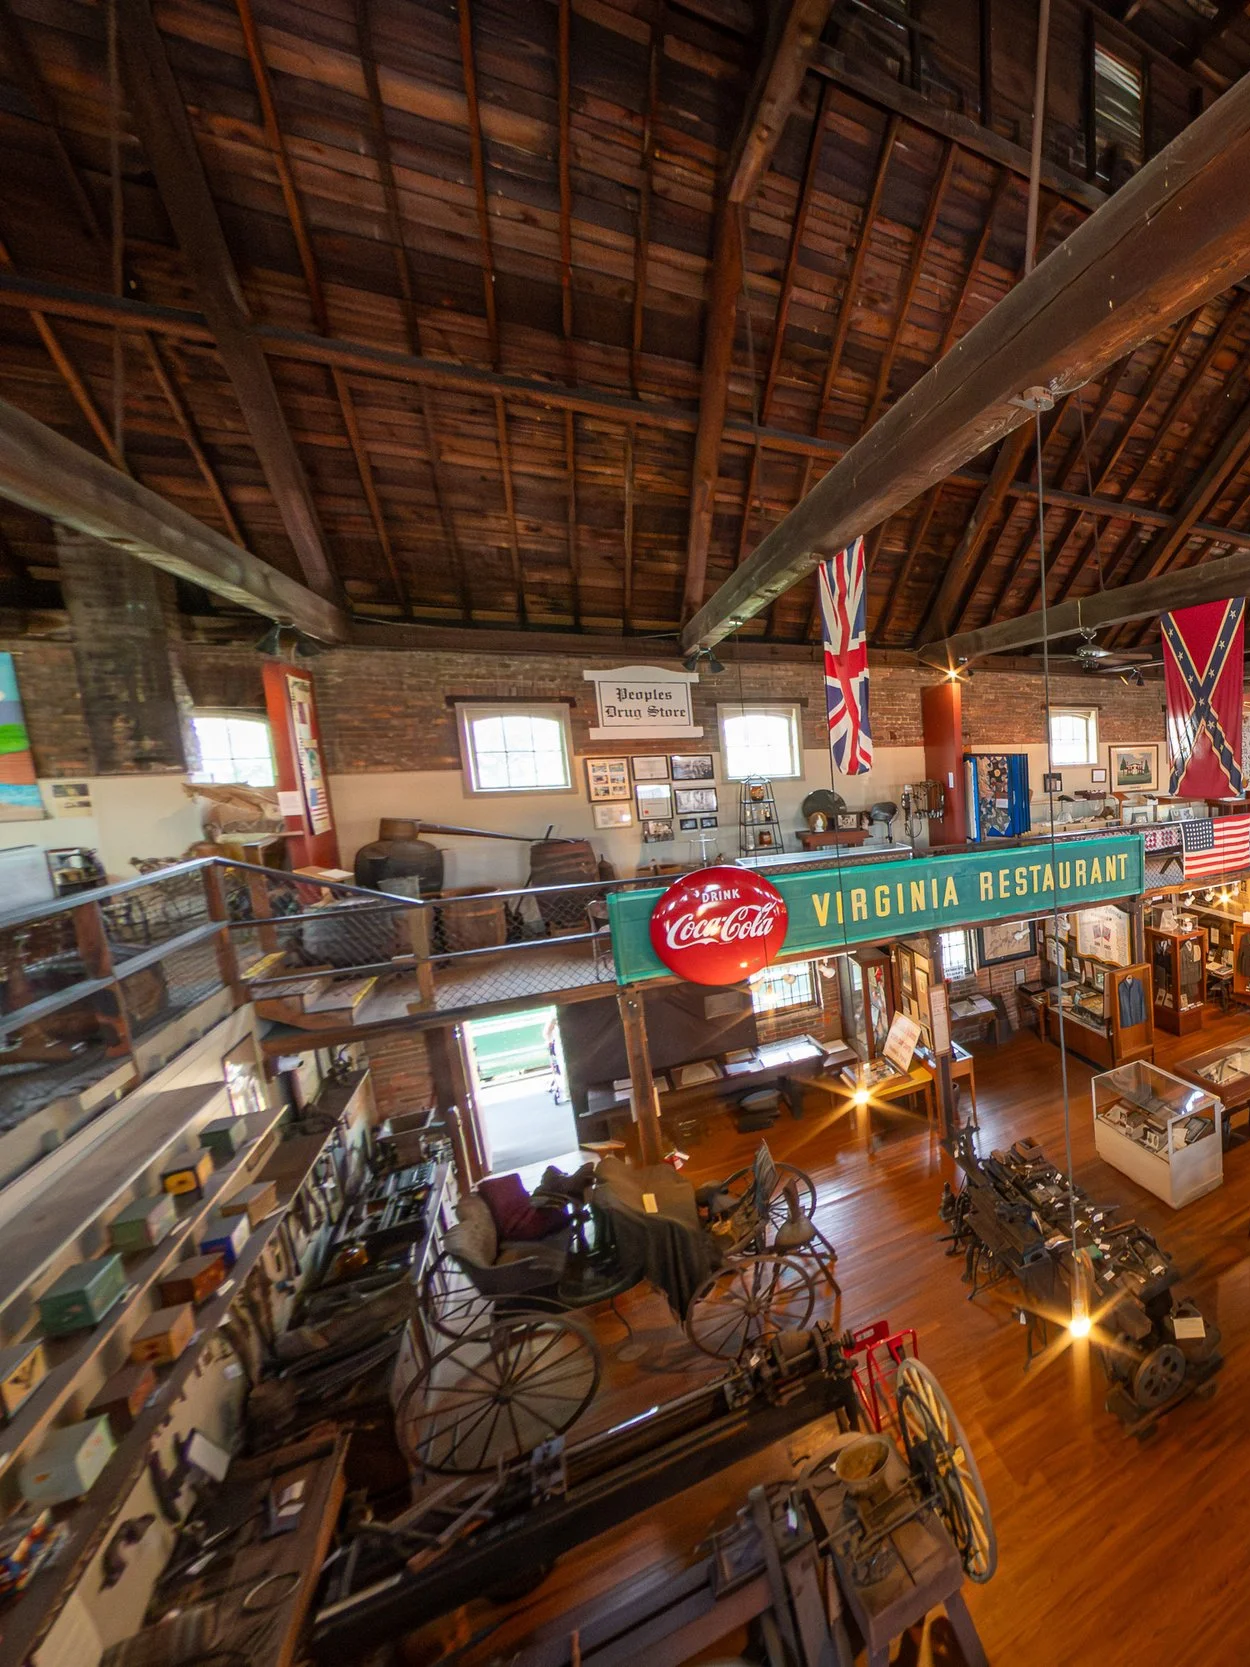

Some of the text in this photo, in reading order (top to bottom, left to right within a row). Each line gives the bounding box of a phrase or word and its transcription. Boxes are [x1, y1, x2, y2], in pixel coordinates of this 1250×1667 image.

[615, 687, 673, 703] Peoples
[604, 705, 687, 720] Drug Store
[701, 888, 741, 903] DRINK
[811, 853, 1129, 927] VIRGINIA RESTAURANT
[666, 904, 777, 950] Coca-Cola
